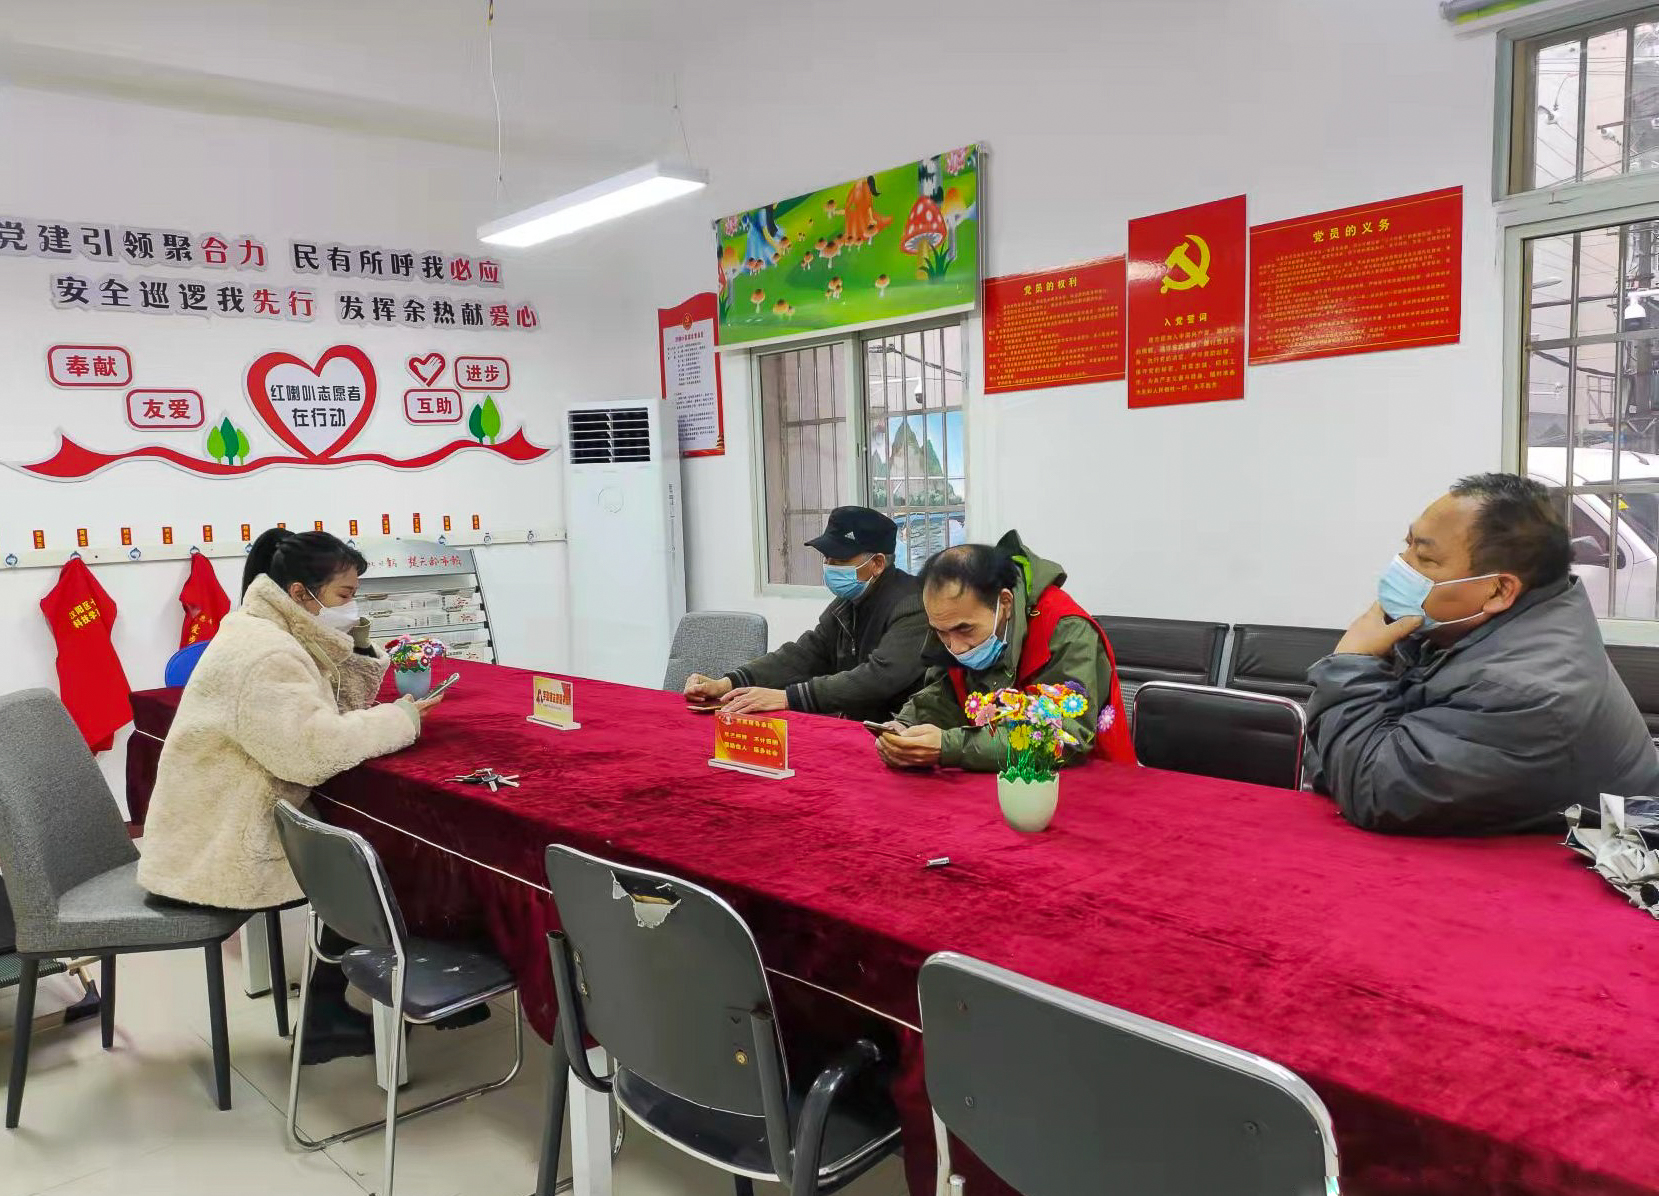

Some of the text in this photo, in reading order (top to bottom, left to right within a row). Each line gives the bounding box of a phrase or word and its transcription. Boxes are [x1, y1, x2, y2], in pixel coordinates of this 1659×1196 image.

[1313, 218, 1390, 243] 党员的义务
[0, 221, 500, 284] 党建引领聚合力 民有所呼我必应
[1023, 276, 1078, 296] 党员的权利
[57, 276, 537, 328] 安全巡逻我先行 发挥余热献爱心
[1164, 312, 1208, 326] 入党誓词
[65, 355, 118, 378] 奉献
[465, 364, 500, 383] 进步
[270, 384, 361, 403] 红喇叭志愿者
[143, 399, 190, 421] 友爱
[417, 397, 452, 415] 互助
[291, 407, 347, 428] 在行动
